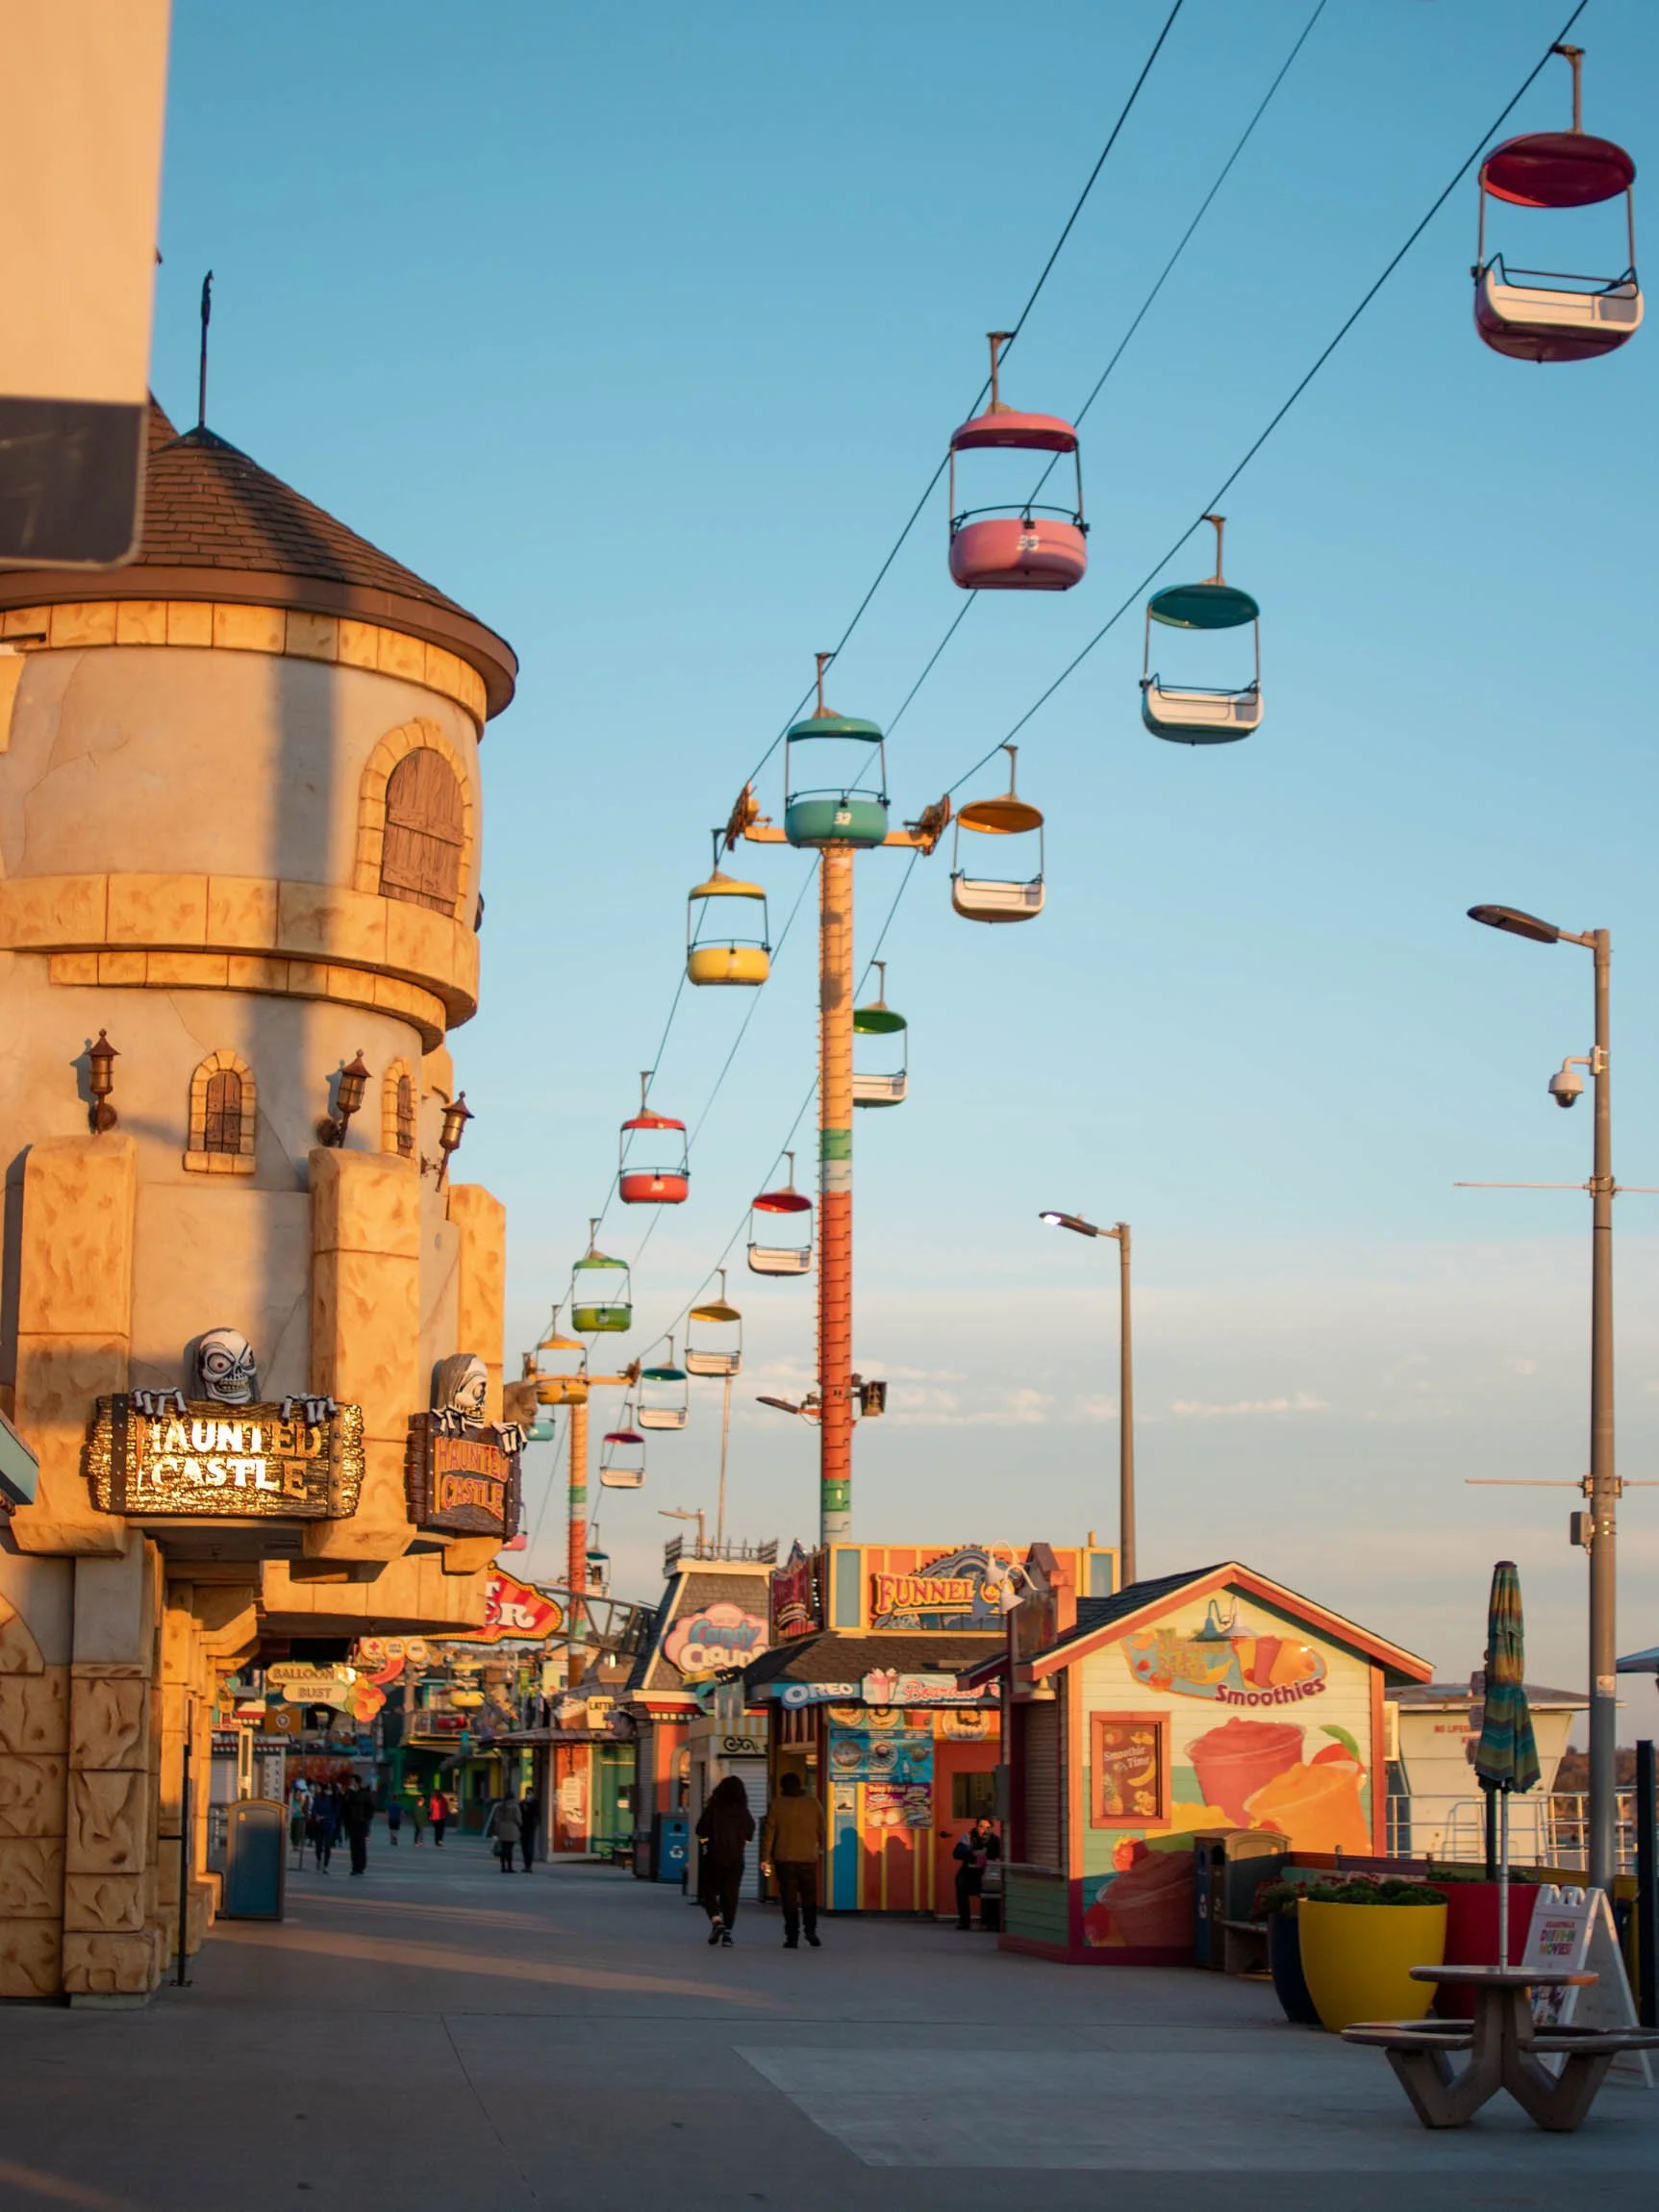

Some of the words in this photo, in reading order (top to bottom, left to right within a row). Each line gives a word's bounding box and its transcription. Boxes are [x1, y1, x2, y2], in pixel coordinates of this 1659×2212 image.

[437, 1439, 510, 1482] HAUNTED
[148, 1457, 308, 1499] CASTLE
[443, 1476, 505, 1521] CASTLE
[877, 1574, 975, 1612] FUNNEL
[690, 1620, 762, 1651] Candy
[273, 1667, 335, 1681] BALLOON
[784, 1683, 854, 1703] OREO
[1215, 1677, 1326, 1706] Smoothies
[1103, 1746, 1145, 1762] Smoothie
[1126, 1756, 1149, 1769] Time
